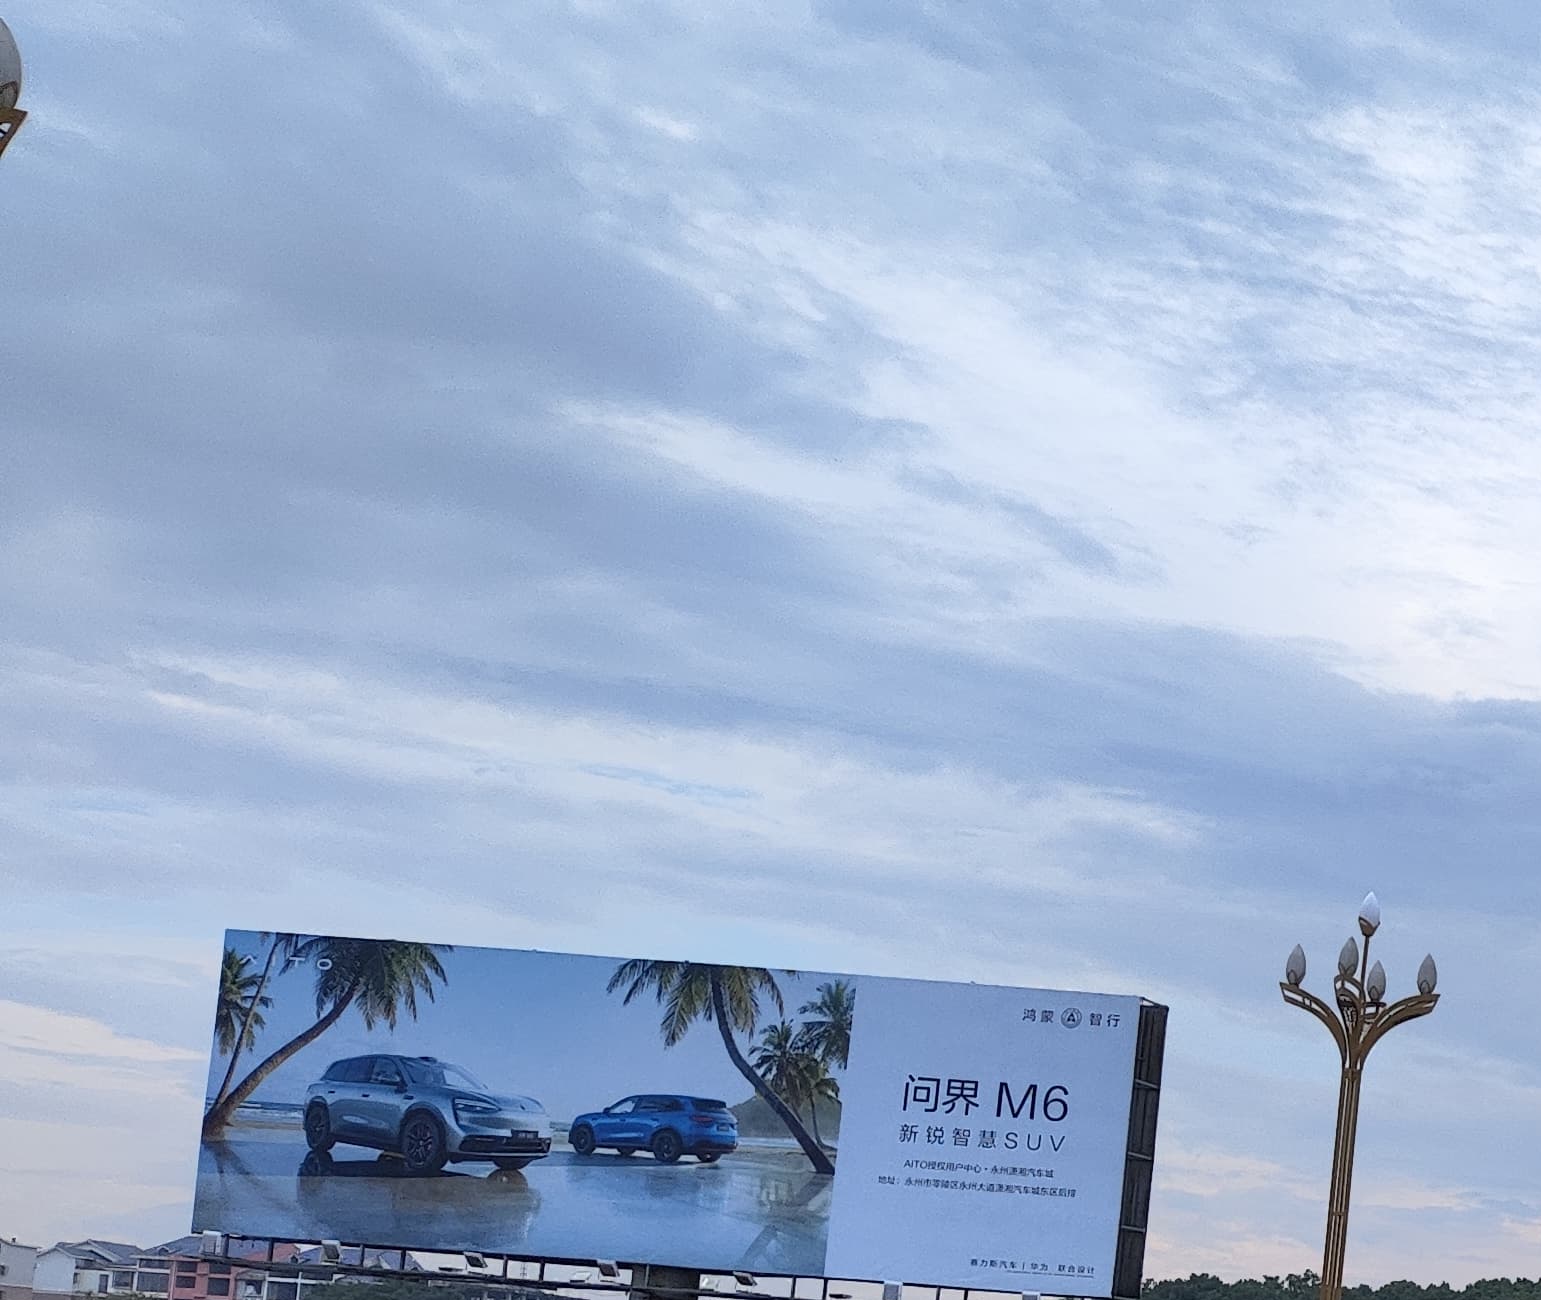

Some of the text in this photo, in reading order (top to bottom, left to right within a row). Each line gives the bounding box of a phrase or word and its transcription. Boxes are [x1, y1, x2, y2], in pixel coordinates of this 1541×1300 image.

[1021, 1007, 1121, 1028] 鸿蒙 智行
[902, 1073, 1070, 1122] 问界 M6
